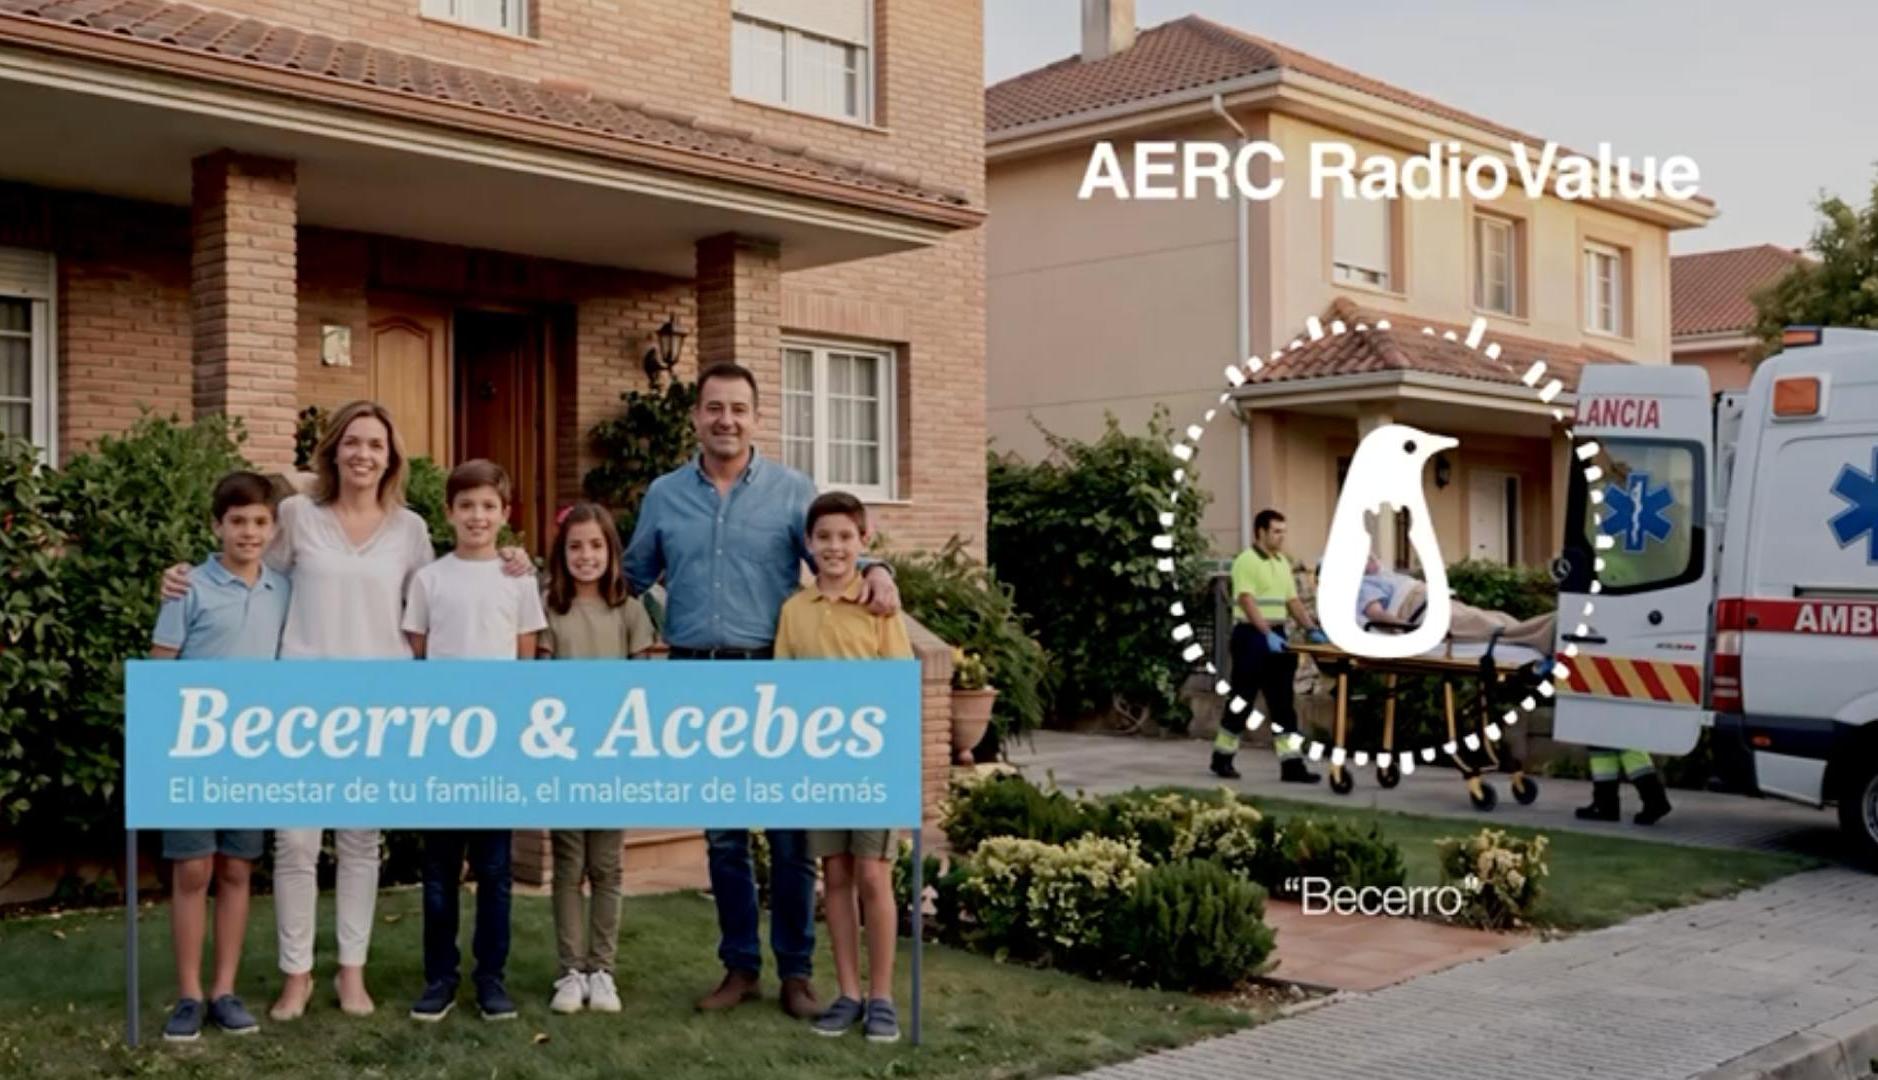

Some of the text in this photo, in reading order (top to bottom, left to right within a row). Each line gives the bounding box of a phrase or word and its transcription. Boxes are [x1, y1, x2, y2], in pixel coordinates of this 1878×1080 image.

[1794, 603, 1878, 635] AMB
[168, 682, 888, 761] Becerro & Acebes
[169, 775, 888, 807] El bienestar de tu familia, el malestar de las demás
